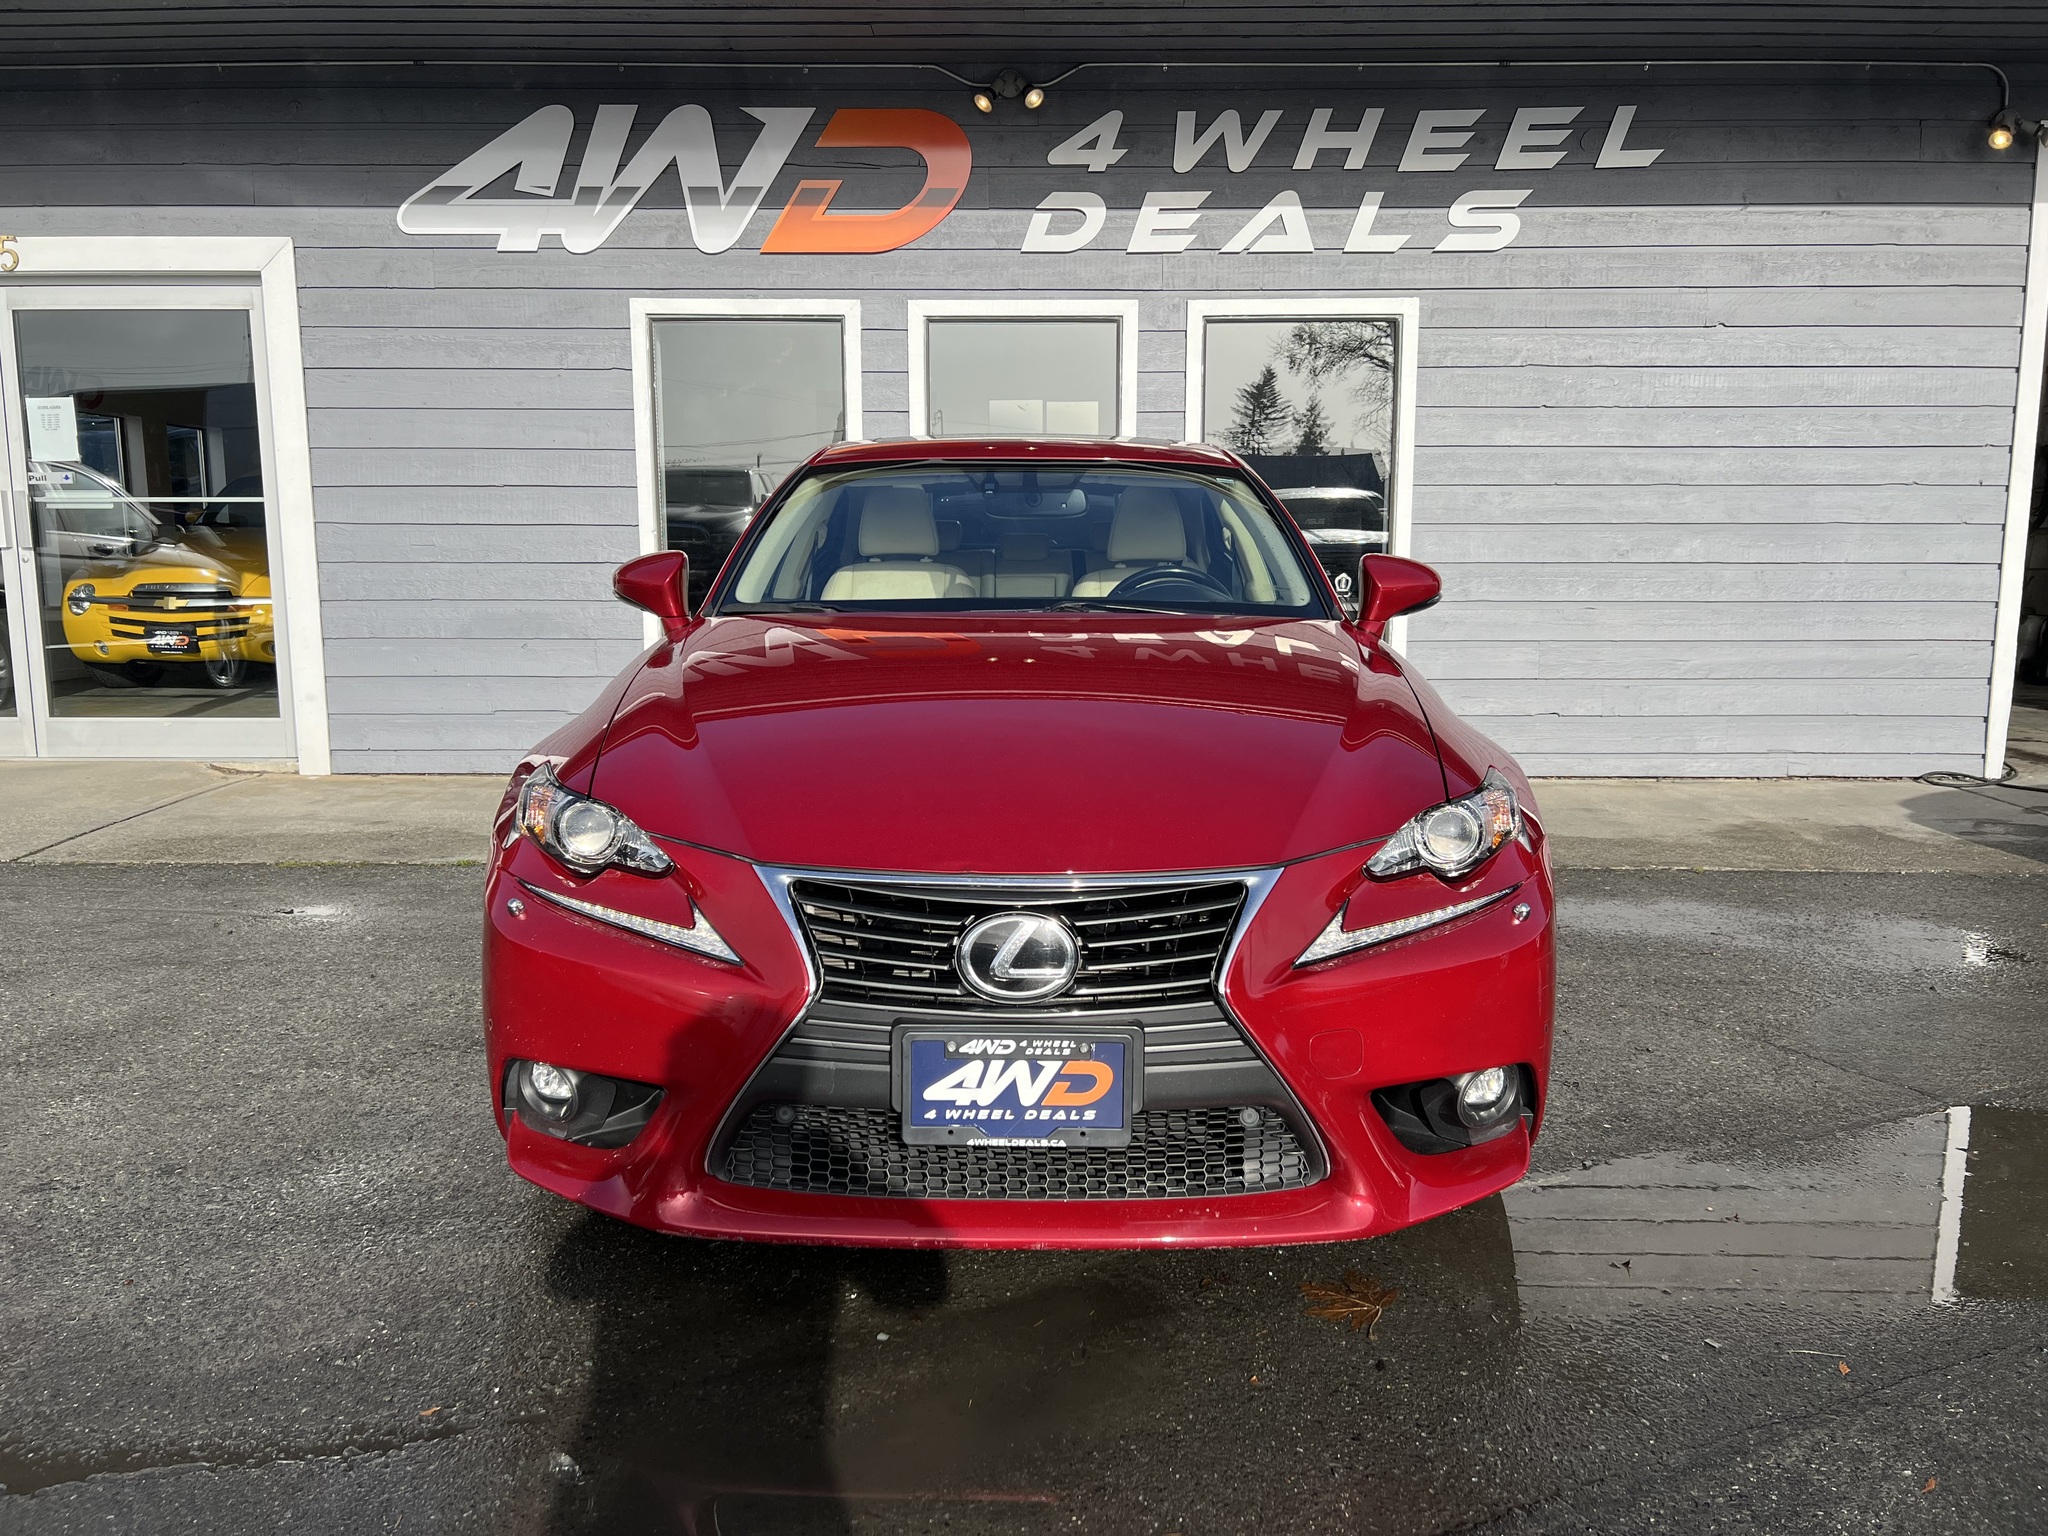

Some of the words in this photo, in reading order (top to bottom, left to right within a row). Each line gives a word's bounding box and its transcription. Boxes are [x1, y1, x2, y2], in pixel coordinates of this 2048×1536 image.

[1047, 109, 1128, 172] 4
[1172, 105, 1665, 173] WHEEL
[396, 104, 973, 254] 4WD
[1020, 189, 1534, 254] DEALS
[0, 235, 19, 272] 5
[958, 1039, 1016, 1055] 4WD
[1032, 1040, 1077, 1048] WHEEL
[922, 1060, 1114, 1107] 4WD
[923, 1109, 937, 1120] 4
[945, 1109, 1015, 1120] WHEEL
[1024, 1109, 1097, 1121] DEALS
[966, 1138, 1067, 1147] 4WHEELDEALS.CA
